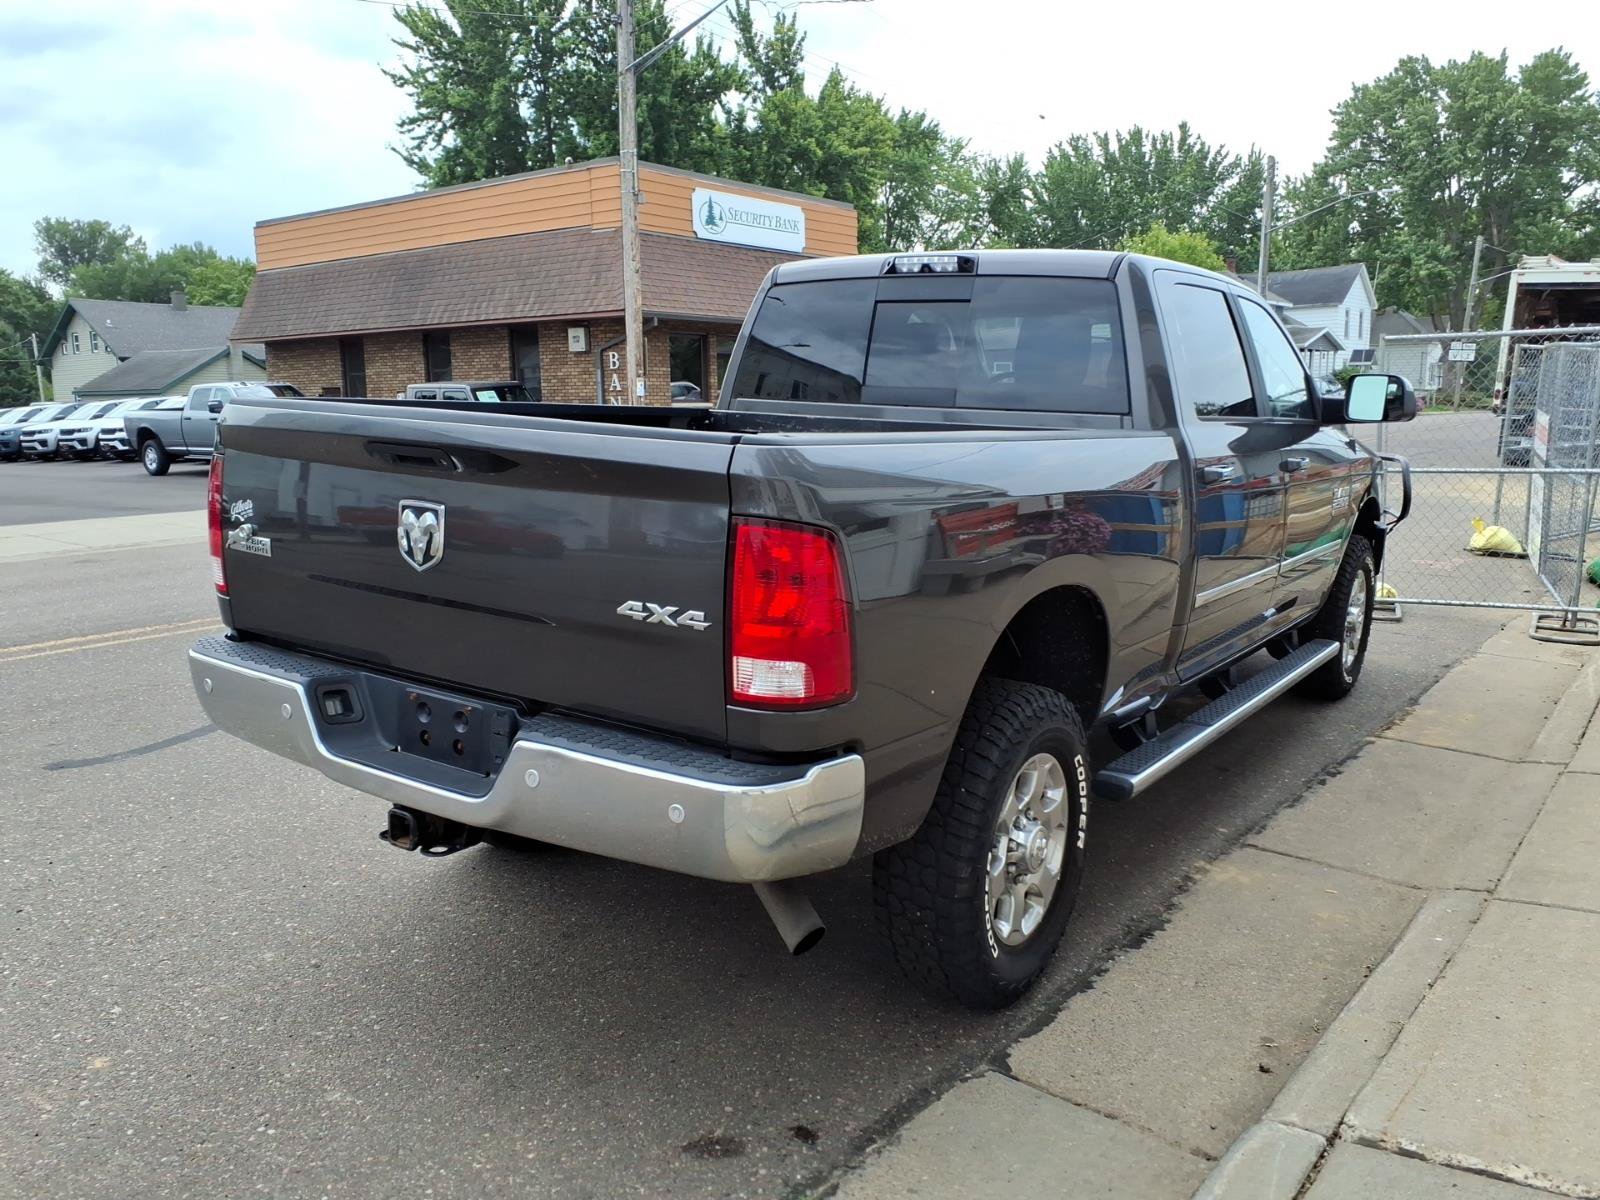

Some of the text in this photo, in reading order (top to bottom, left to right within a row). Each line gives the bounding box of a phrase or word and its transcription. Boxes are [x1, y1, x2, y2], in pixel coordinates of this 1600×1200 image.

[728, 207, 800, 232] SECURITY BANK
[1074, 754, 1088, 850] COOPER
